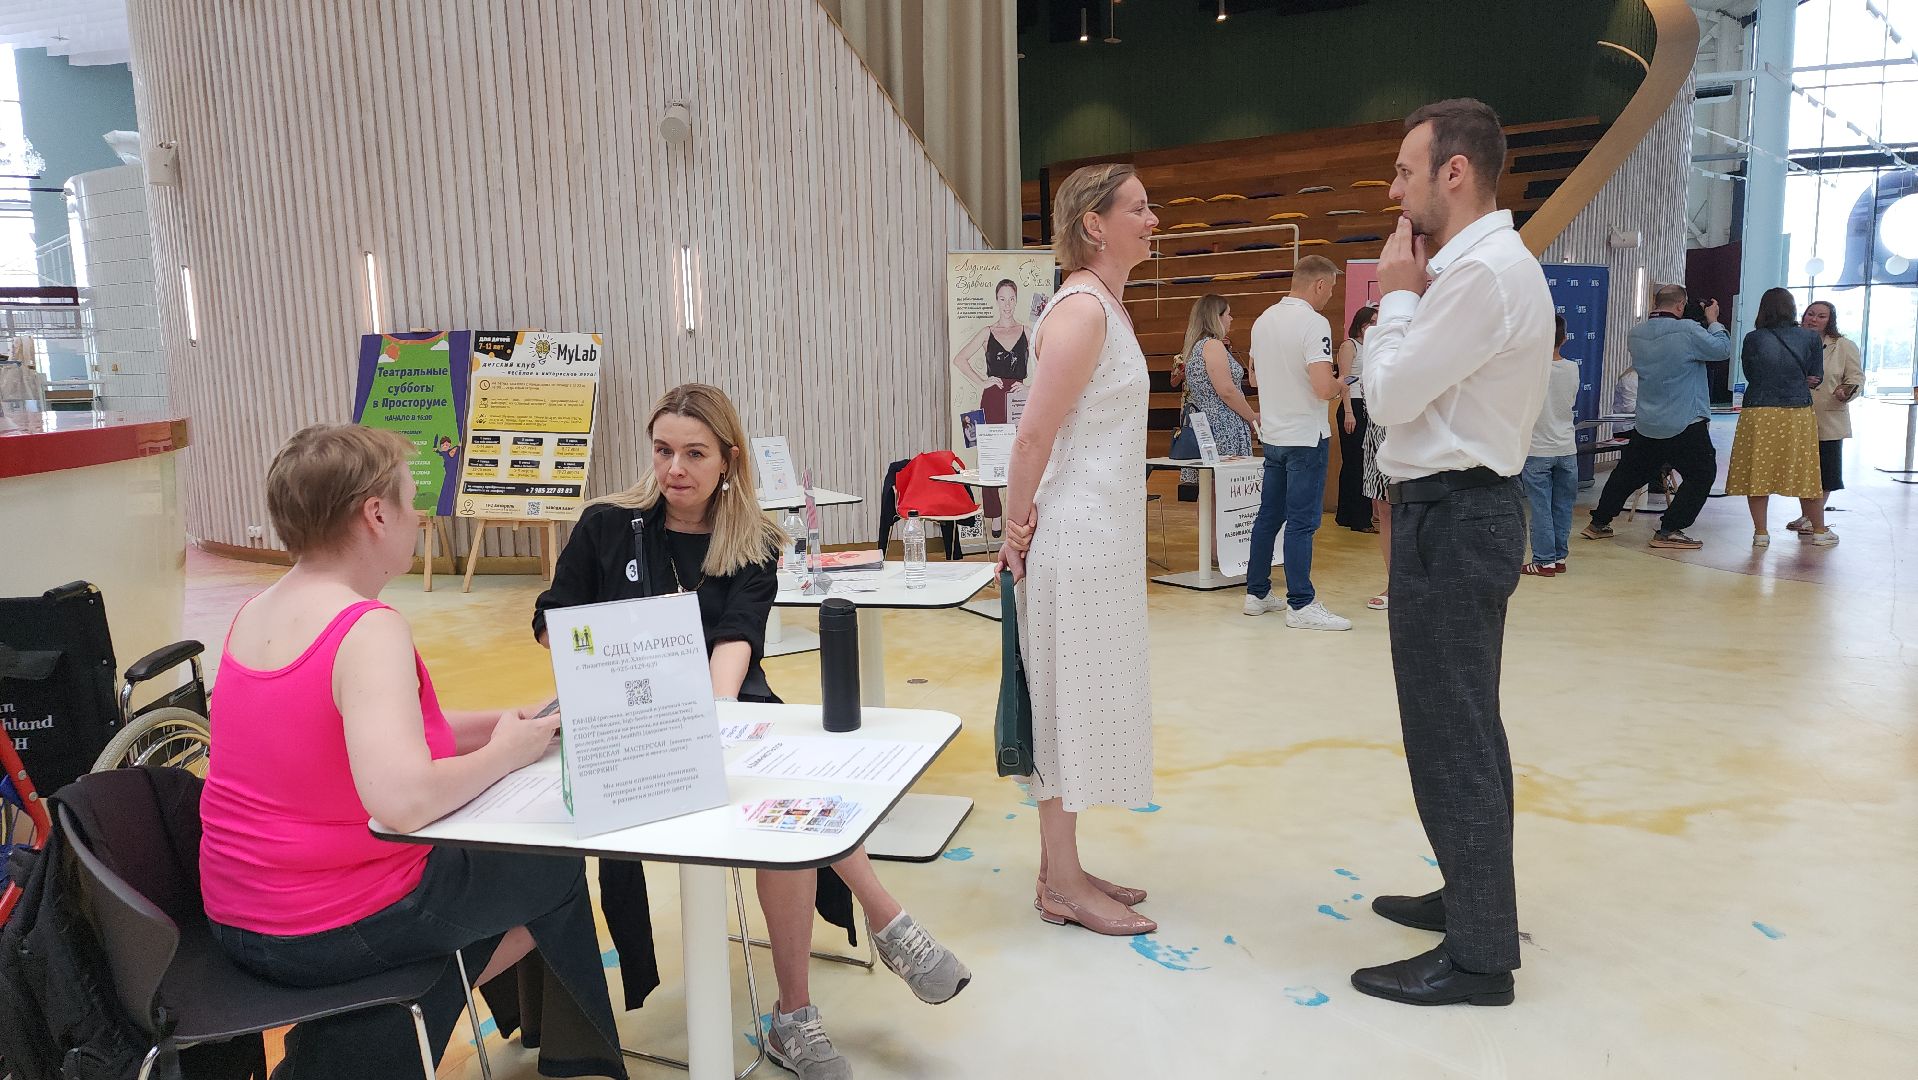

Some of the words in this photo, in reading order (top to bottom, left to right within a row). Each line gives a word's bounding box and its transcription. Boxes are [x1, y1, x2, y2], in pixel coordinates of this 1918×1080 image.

[1321, 336, 1331, 356] 3
[556, 343, 597, 365] MyLab
[378, 366, 448, 379] Театральные
[516, 361, 536, 371] клуб
[388, 382, 435, 396] субботы
[372, 400, 379, 408] в
[382, 397, 448, 410] Просторуме
[1244, 481, 1261, 496] КУХ
[603, 643, 631, 657] СДЦ
[633, 634, 694, 652] МАРИРОС
[0, 714, 54, 731] hland
